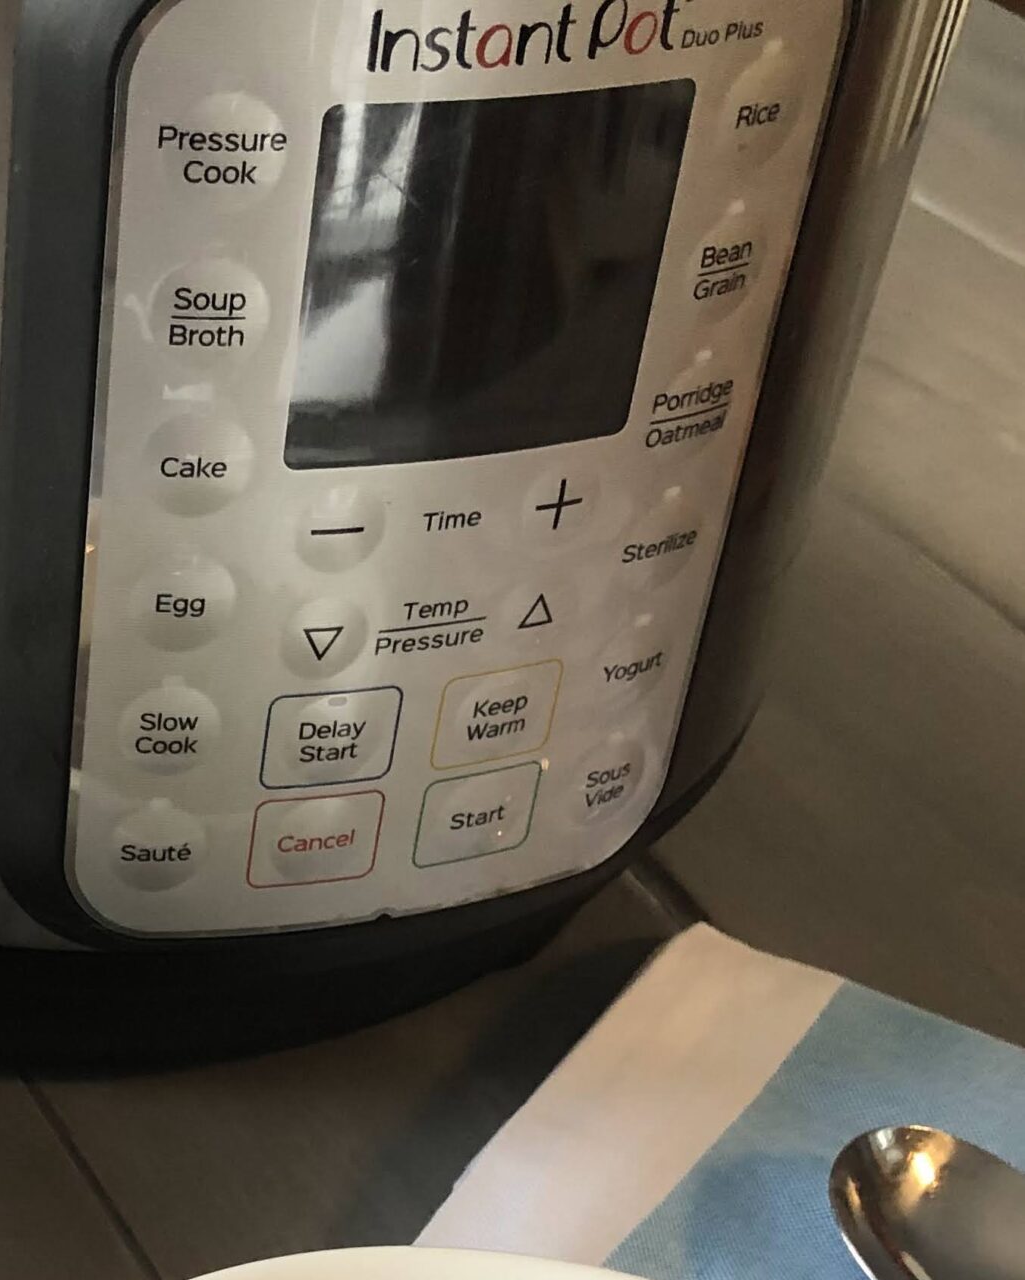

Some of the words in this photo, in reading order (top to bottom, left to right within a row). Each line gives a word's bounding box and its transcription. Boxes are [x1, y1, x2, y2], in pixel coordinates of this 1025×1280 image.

[366, 3, 576, 72] Instant
[680, 28, 720, 50] Duo
[724, 20, 764, 43] Plus
[735, 101, 780, 129] Rice
[158, 125, 288, 153] Pressure
[183, 160, 257, 186] Cook
[700, 240, 753, 269] Bean
[692, 272, 746, 300] Grain
[174, 288, 246, 312] Soup
[168, 324, 244, 347] Broth
[652, 378, 734, 416] Porridge
[645, 412, 725, 449] Oatmeal
[160, 457, 227, 479] Cake
[423, 509, 482, 533] Time
[621, 528, 698, 564] Sterilize
[155, 594, 206, 617] Egg
[404, 596, 469, 621] Temp
[374, 626, 484, 656] Pressure
[603, 651, 663, 683] Yogurt
[473, 694, 528, 719] Keep
[139, 712, 199, 732] Slow
[298, 719, 367, 741] Delay
[466, 717, 526, 743] Warm
[135, 737, 198, 755] Cook
[299, 744, 358, 763] Start
[586, 761, 631, 788] Sous
[585, 783, 625, 808] Vide
[449, 804, 505, 831] Start
[120, 842, 192, 863] Sauté
[277, 829, 356, 853] Cancel
